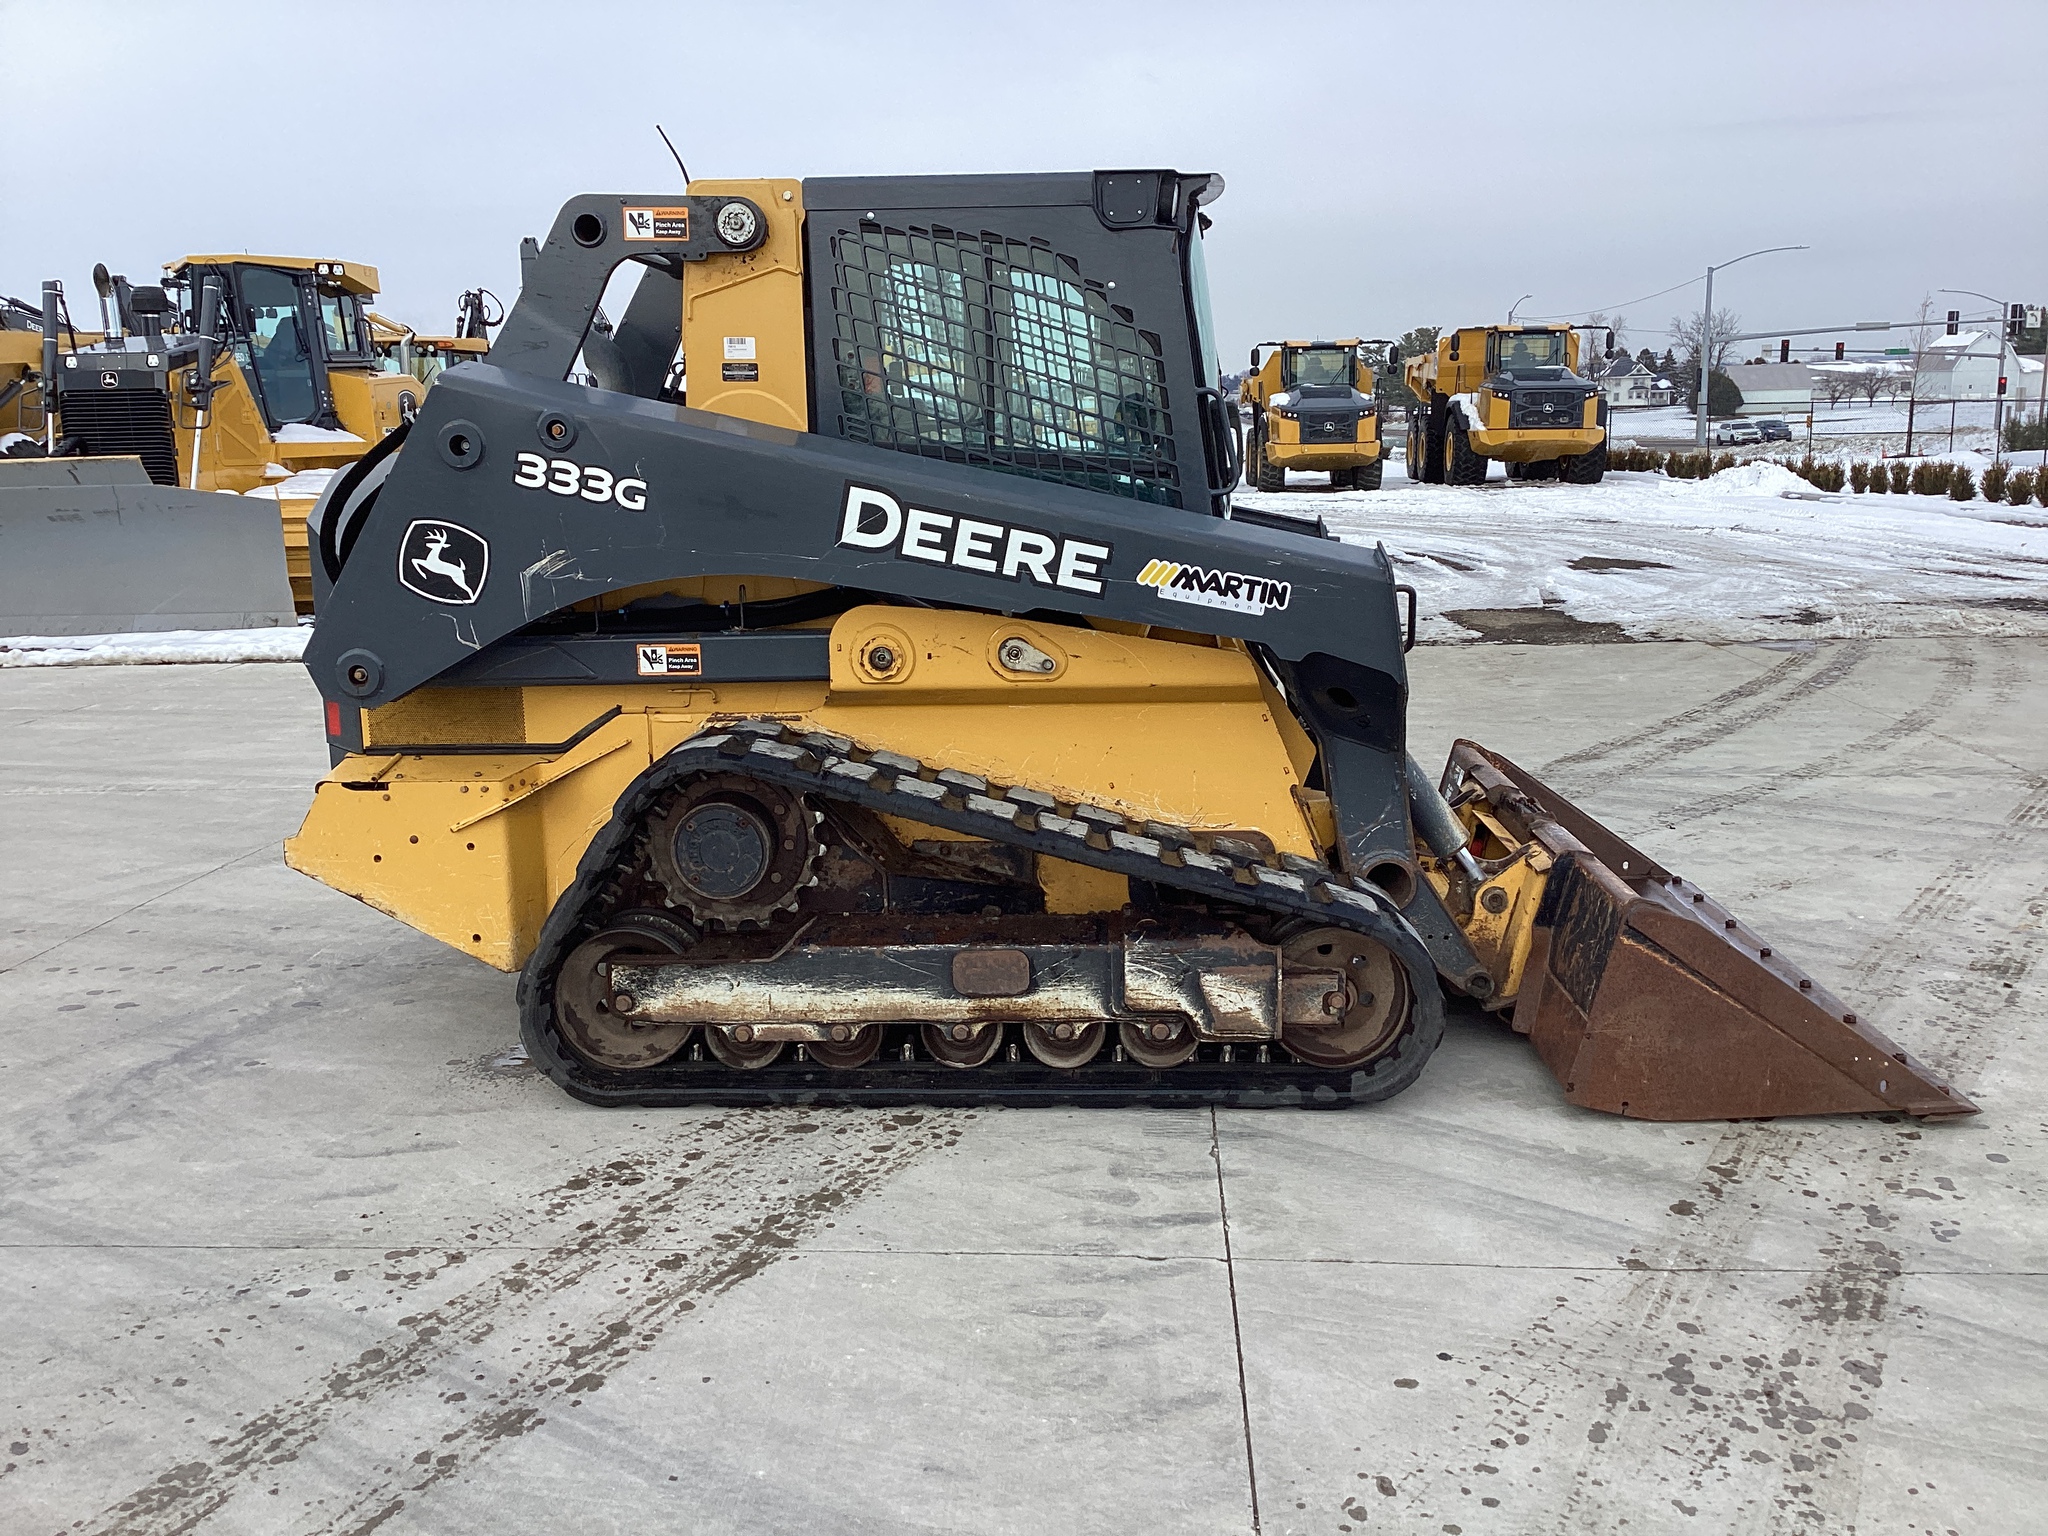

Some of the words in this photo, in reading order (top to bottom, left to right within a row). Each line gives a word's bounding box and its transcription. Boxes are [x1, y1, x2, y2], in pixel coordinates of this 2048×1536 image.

[514, 452, 647, 511] 333G
[840, 485, 1110, 594] DEERE
[1159, 588, 1263, 613] Equipment
[1170, 567, 1288, 608] MARTIN
